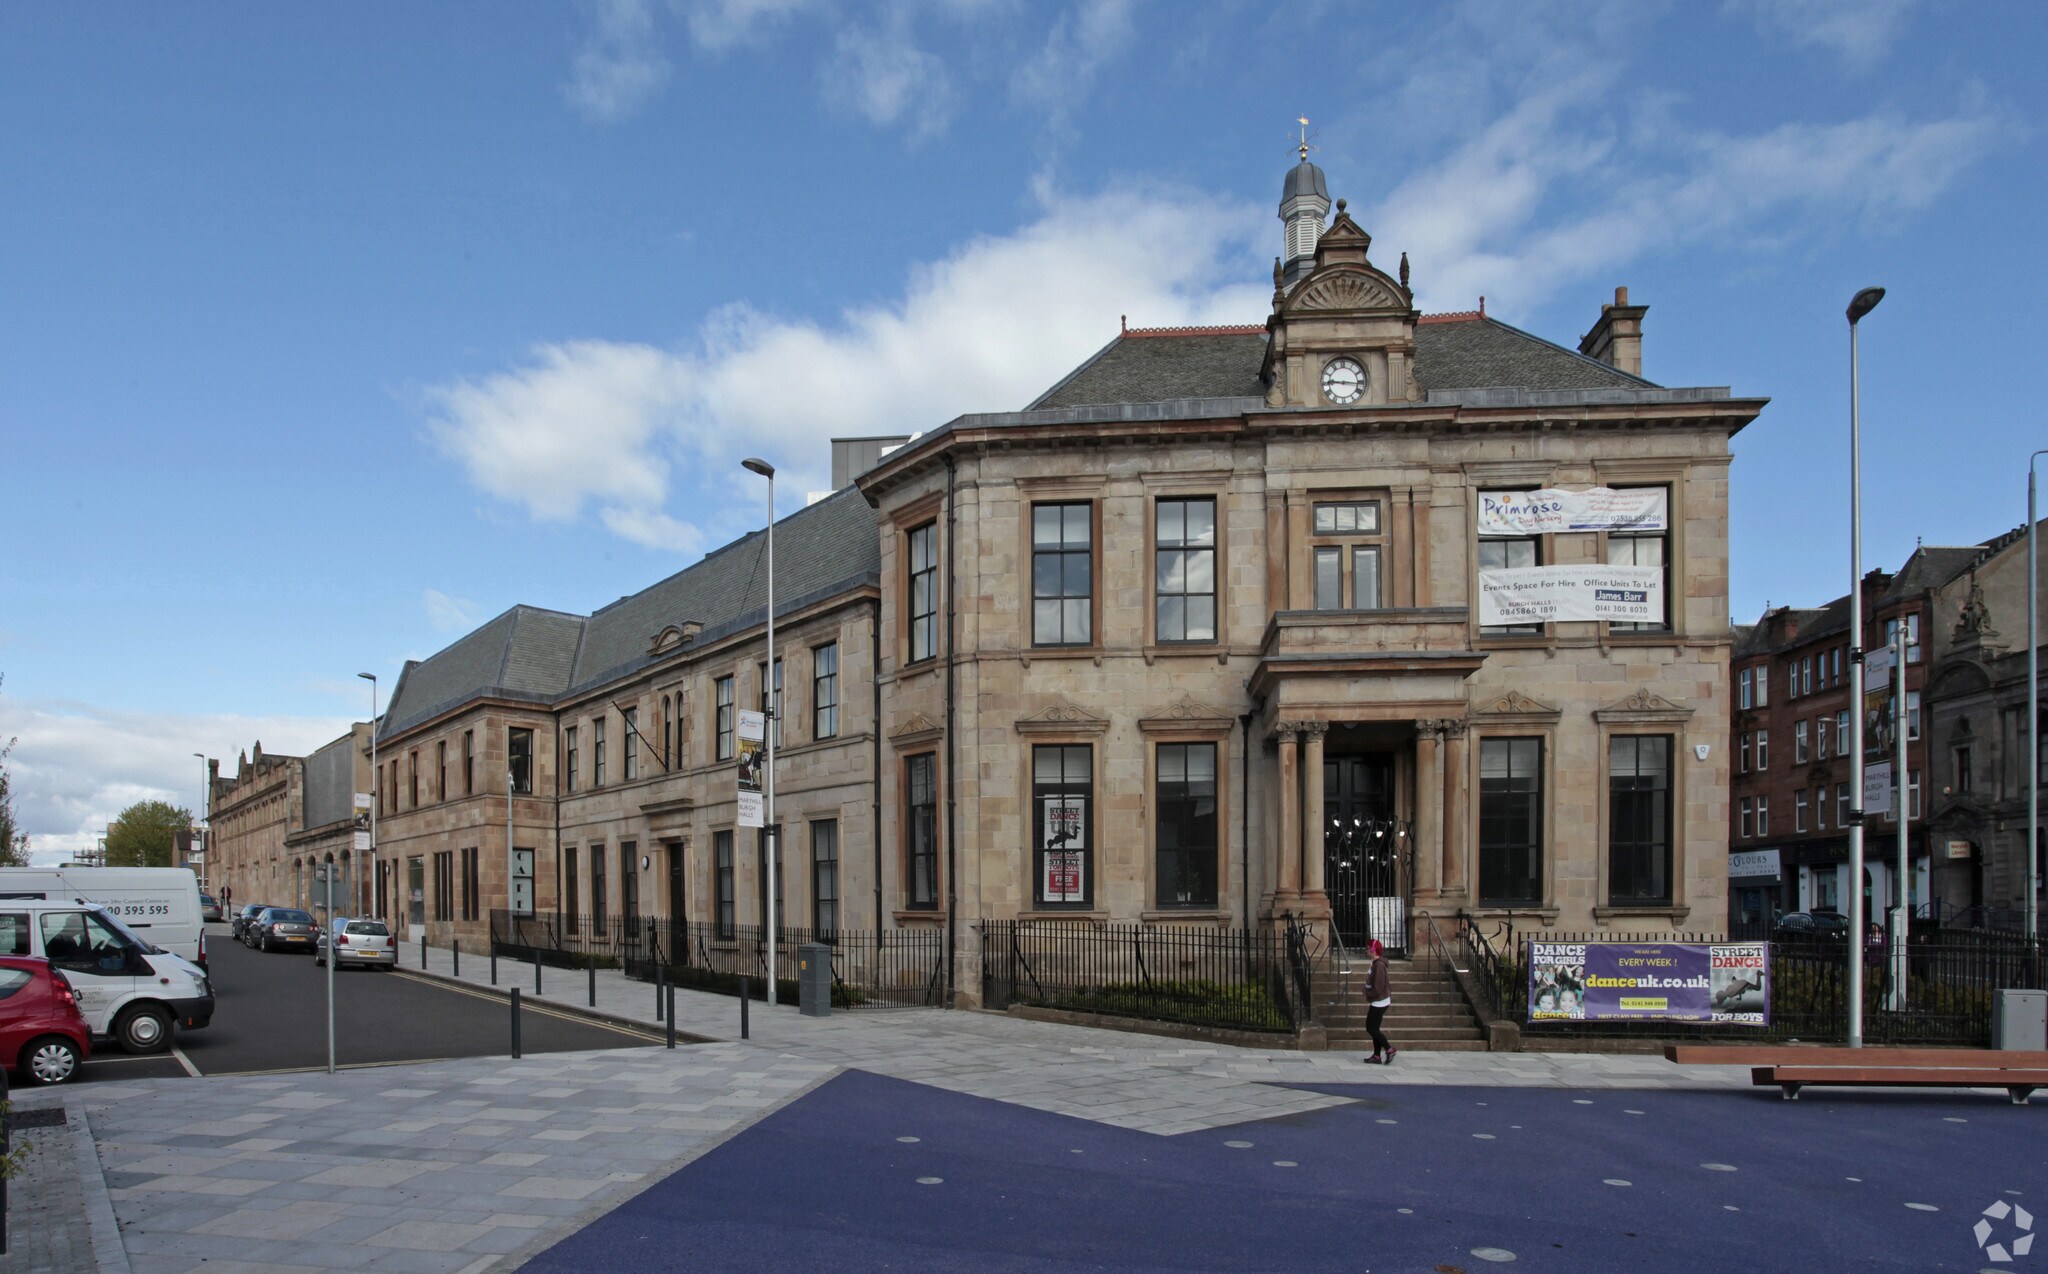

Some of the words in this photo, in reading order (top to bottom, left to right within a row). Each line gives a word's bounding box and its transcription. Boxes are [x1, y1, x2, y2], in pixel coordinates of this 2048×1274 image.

[1484, 498, 1562, 516] Primrose
[1483, 584, 1511, 592] Events
[1513, 582, 1538, 592] Space
[1541, 580, 1555, 588] For
[1584, 579, 1608, 587] Office
[1610, 580, 1629, 588] Units
[1632, 580, 1641, 588] To
[1644, 581, 1656, 589] Let
[1596, 590, 1622, 601] James
[1623, 591, 1642, 602] Barr
[1540, 605, 1557, 613] 1891
[1595, 604, 1610, 612] 0141
[1613, 605, 1626, 613] 300
[1865, 783, 1883, 792] BURGH
[516, 851, 527, 909] CAFE
[124, 906, 145, 915] 595
[149, 905, 169, 915] 595
[1533, 944, 1586, 956] DANCE
[1711, 947, 1763, 957] STREET
[1533, 956, 1555, 965] FOR
[1555, 956, 1586, 965] GIRLS
[1619, 958, 1645, 967] EVERY
[1646, 958, 1672, 967] WEEK
[1711, 957, 1763, 968] DANCE
[1585, 974, 1710, 988] danceuk.co.uk
[1533, 1010, 1586, 1020] danceuk
[1711, 1012, 1734, 1021] FOR
[1734, 1012, 1764, 1022] BOYS
